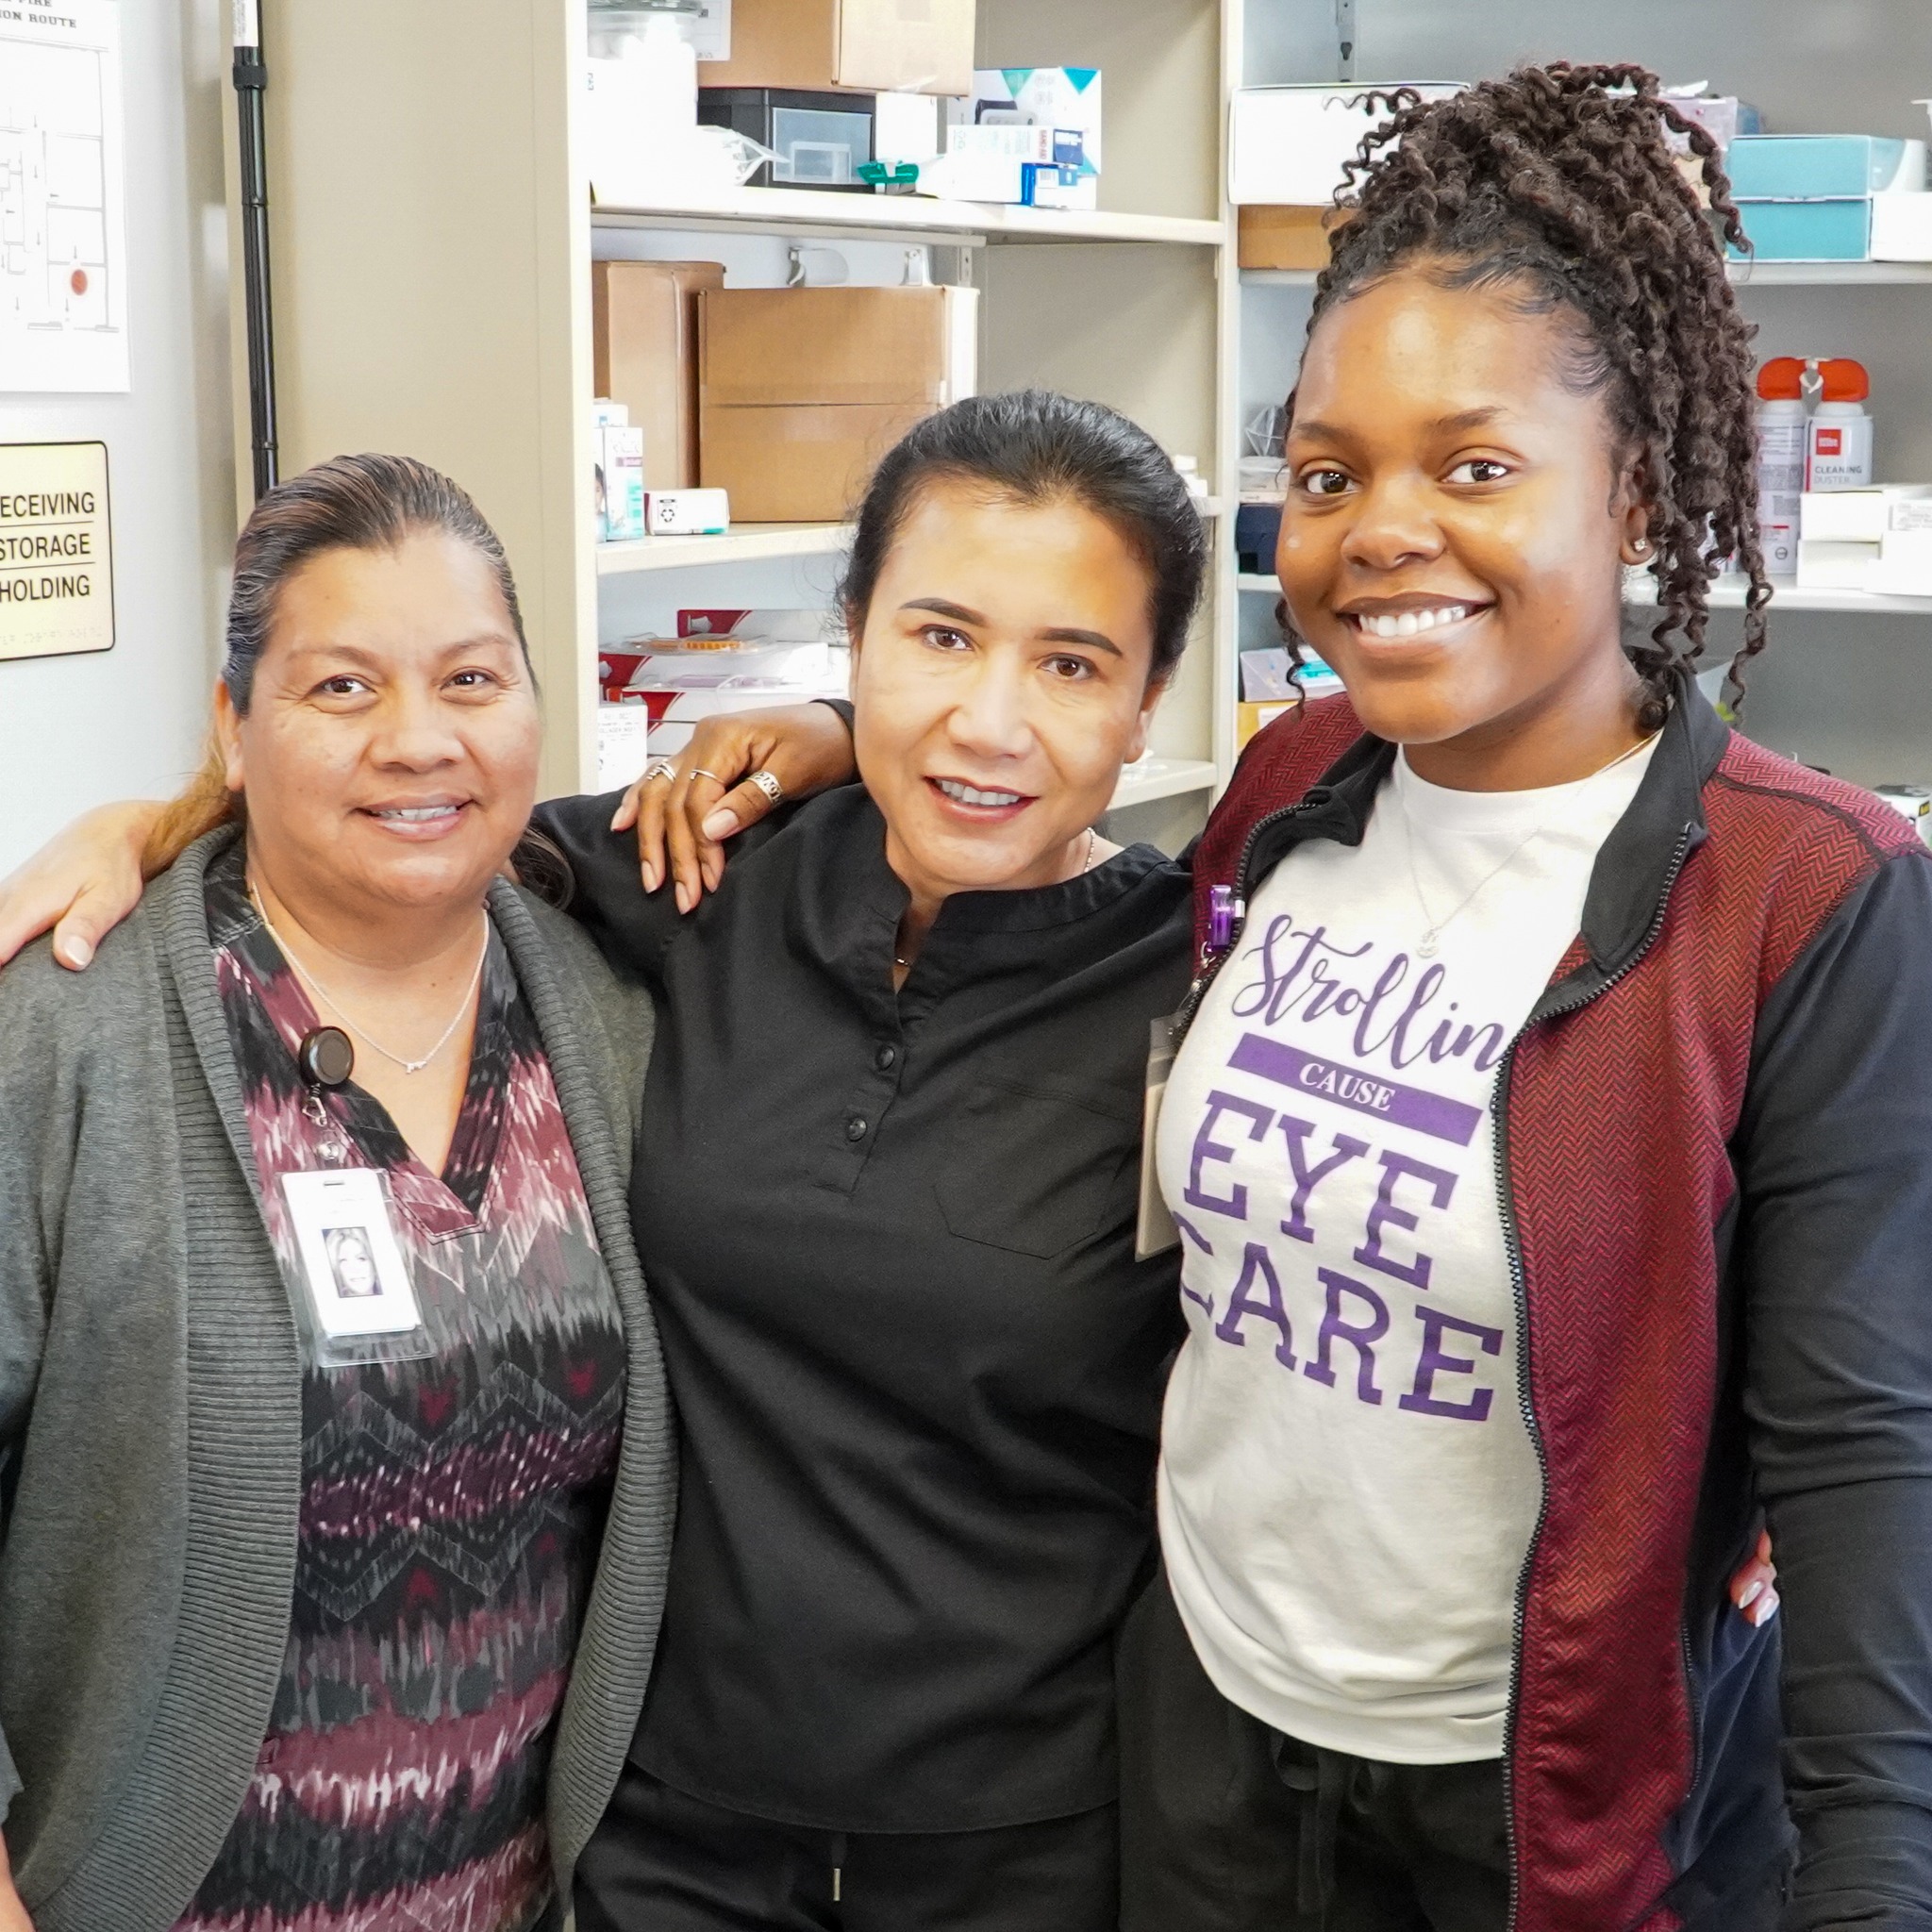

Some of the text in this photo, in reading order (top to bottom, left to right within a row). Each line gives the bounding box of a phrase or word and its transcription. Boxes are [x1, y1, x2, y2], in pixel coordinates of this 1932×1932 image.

[28, 13, 76, 27] ROUTE
[1815, 465, 1862, 475] CLEANING
[0, 491, 94, 517] ECEIVING
[0, 533, 91, 560] STORAGE
[0, 575, 91, 603] HOLDING
[1231, 914, 1506, 1073] Strollin
[1299, 1062, 1396, 1112] CAUSE
[1183, 1090, 1460, 1291] EYE
